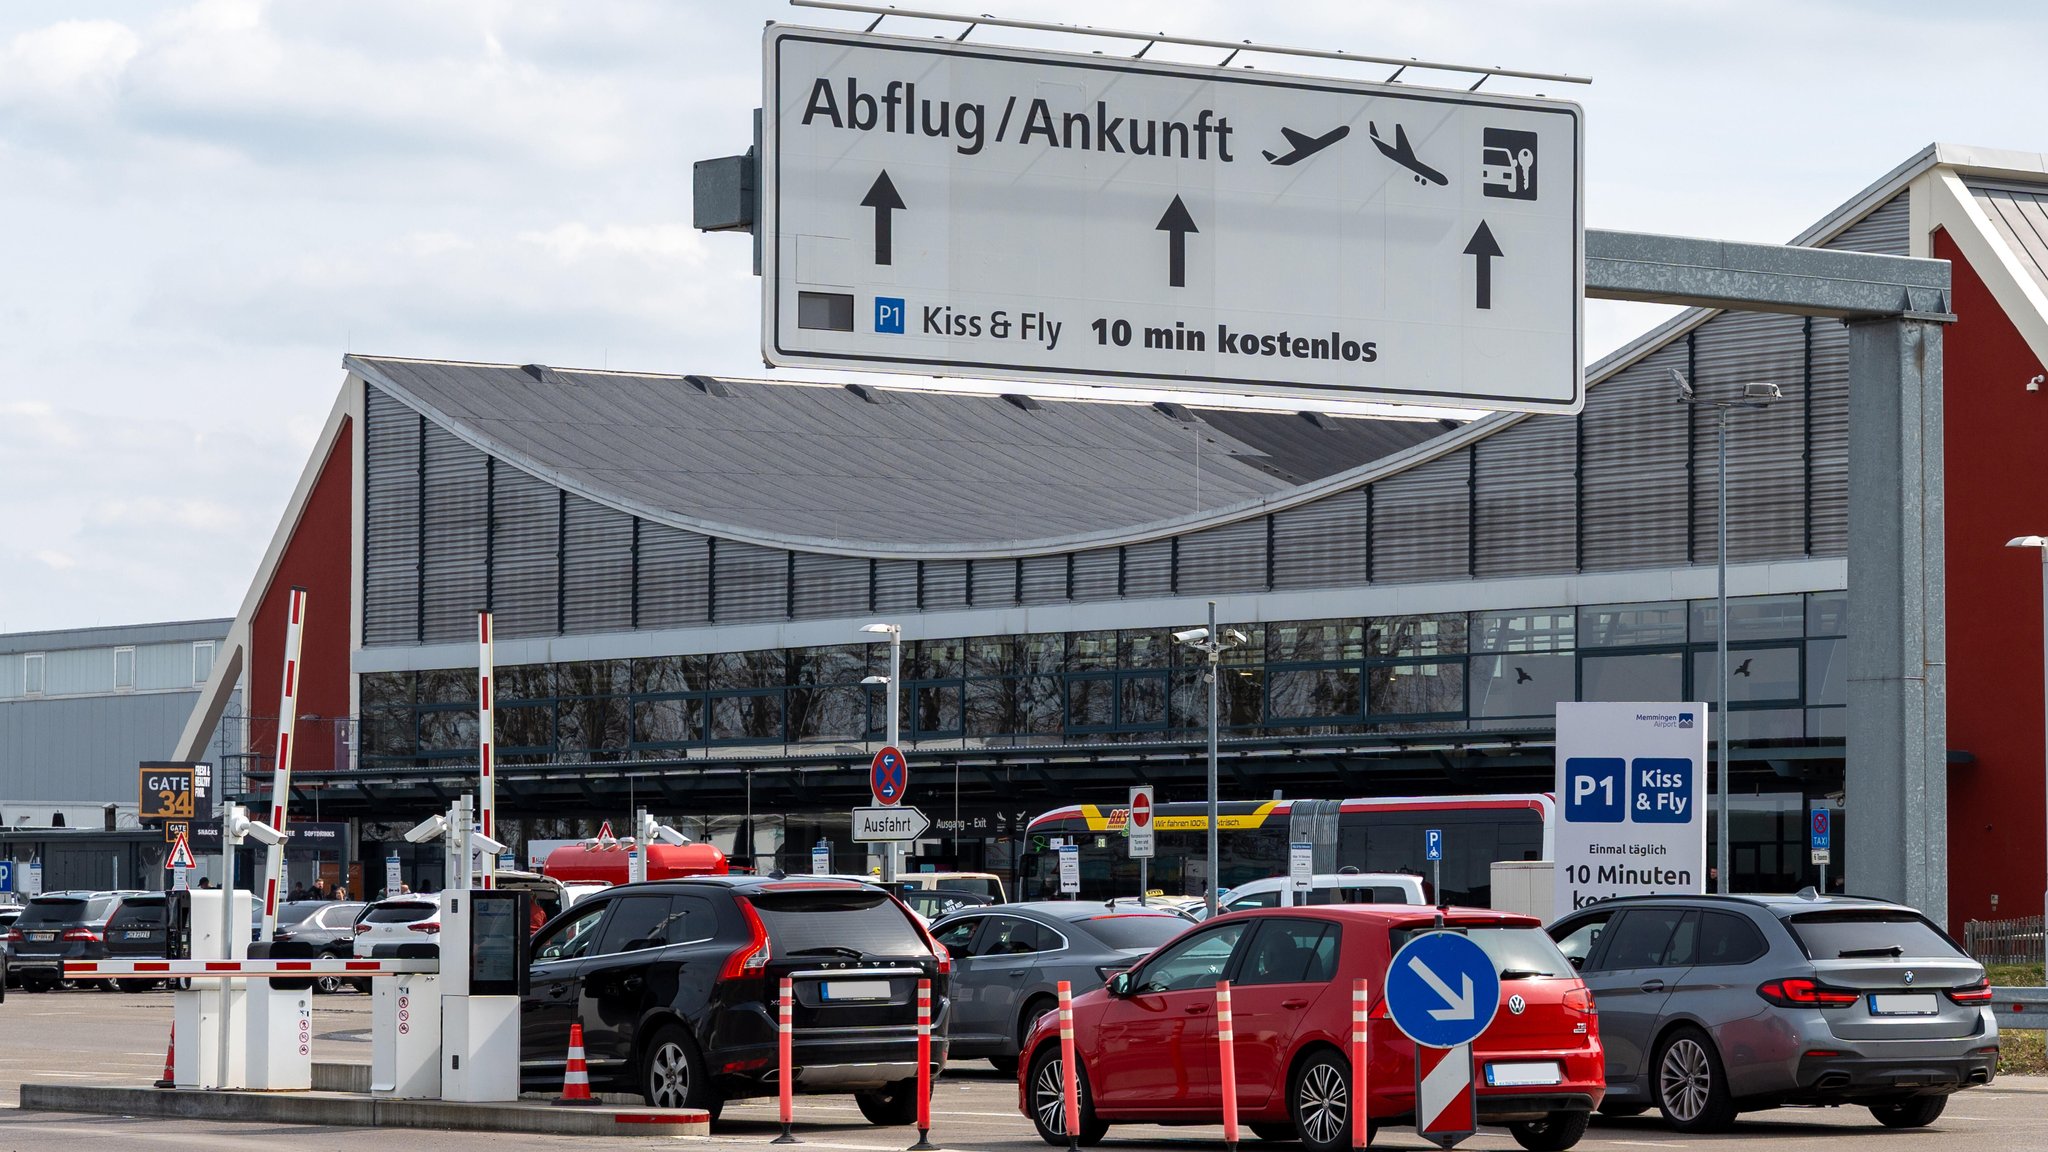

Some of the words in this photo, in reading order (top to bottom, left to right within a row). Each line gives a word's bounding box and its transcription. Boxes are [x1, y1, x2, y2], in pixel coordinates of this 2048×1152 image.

[879, 304, 902, 328] P1
[923, 306, 982, 337] Kiss
[990, 310, 1012, 339] &
[1021, 311, 1062, 351] Fly
[1091, 318, 1132, 347] 10
[1144, 321, 1206, 352] min
[1218, 324, 1378, 363] kostenlos
[1636, 713, 1677, 723] Memmingen
[1653, 720, 1677, 728] Airport
[148, 776, 190, 791] GATE
[1641, 769, 1683, 789] Kiss
[1574, 775, 1614, 806] P1
[158, 790, 191, 817] 34
[1636, 792, 1651, 811] &
[1657, 791, 1687, 815] Fly
[1108, 808, 1129, 825] BBS
[1155, 820, 1166, 828] Wir
[1167, 819, 1189, 828] fahren
[1190, 819, 1207, 827] 100%
[169, 824, 187, 832] GATE
[863, 816, 912, 833] Ausfahrt
[936, 818, 965, 831] Ausgang
[973, 817, 987, 828] Exit
[197, 828, 218, 836] SNACKS
[303, 830, 336, 838] SOFTDRINKS
[1813, 836, 1828, 846] TAXI
[1589, 844, 1626, 855] Einmal
[1629, 844, 1667, 857] täglich
[1565, 865, 1591, 884] 10
[1598, 864, 1691, 885] Minuten
[821, 961, 896, 969] VOLVO
